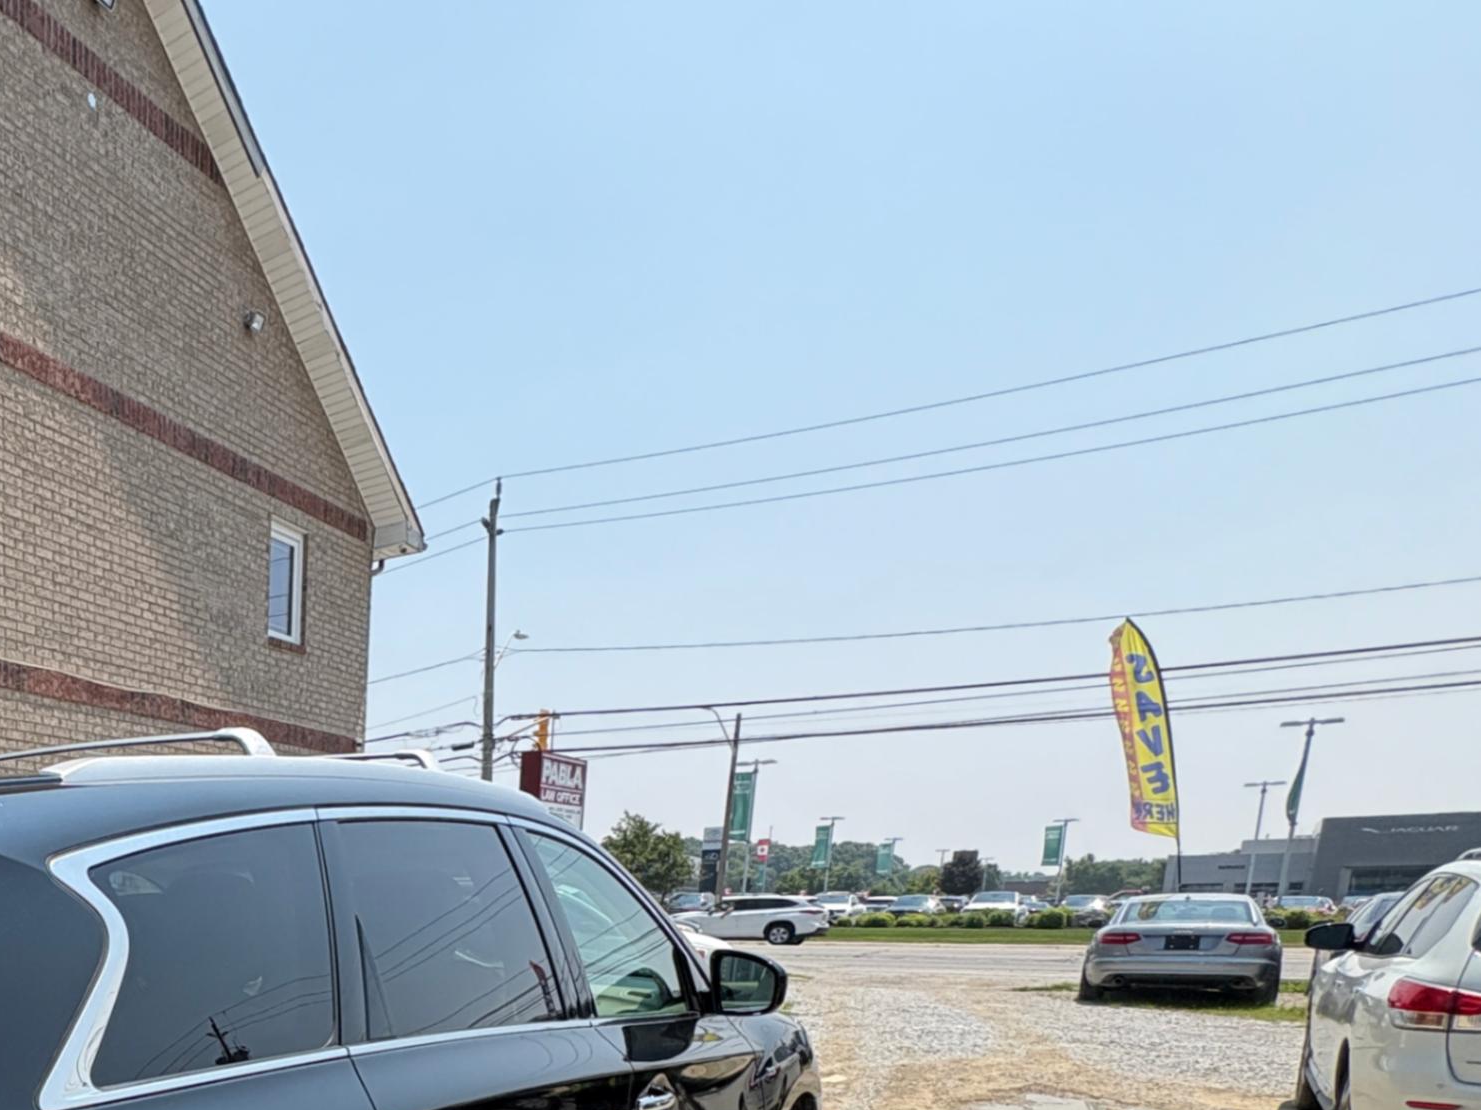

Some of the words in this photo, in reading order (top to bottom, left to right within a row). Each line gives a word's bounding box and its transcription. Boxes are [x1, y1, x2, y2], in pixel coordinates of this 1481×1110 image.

[541, 757, 583, 791] PABLA
[540, 787, 556, 801] LAW
[556, 791, 581, 805] OFFICE
[1389, 824, 1459, 834] JAGUAR
